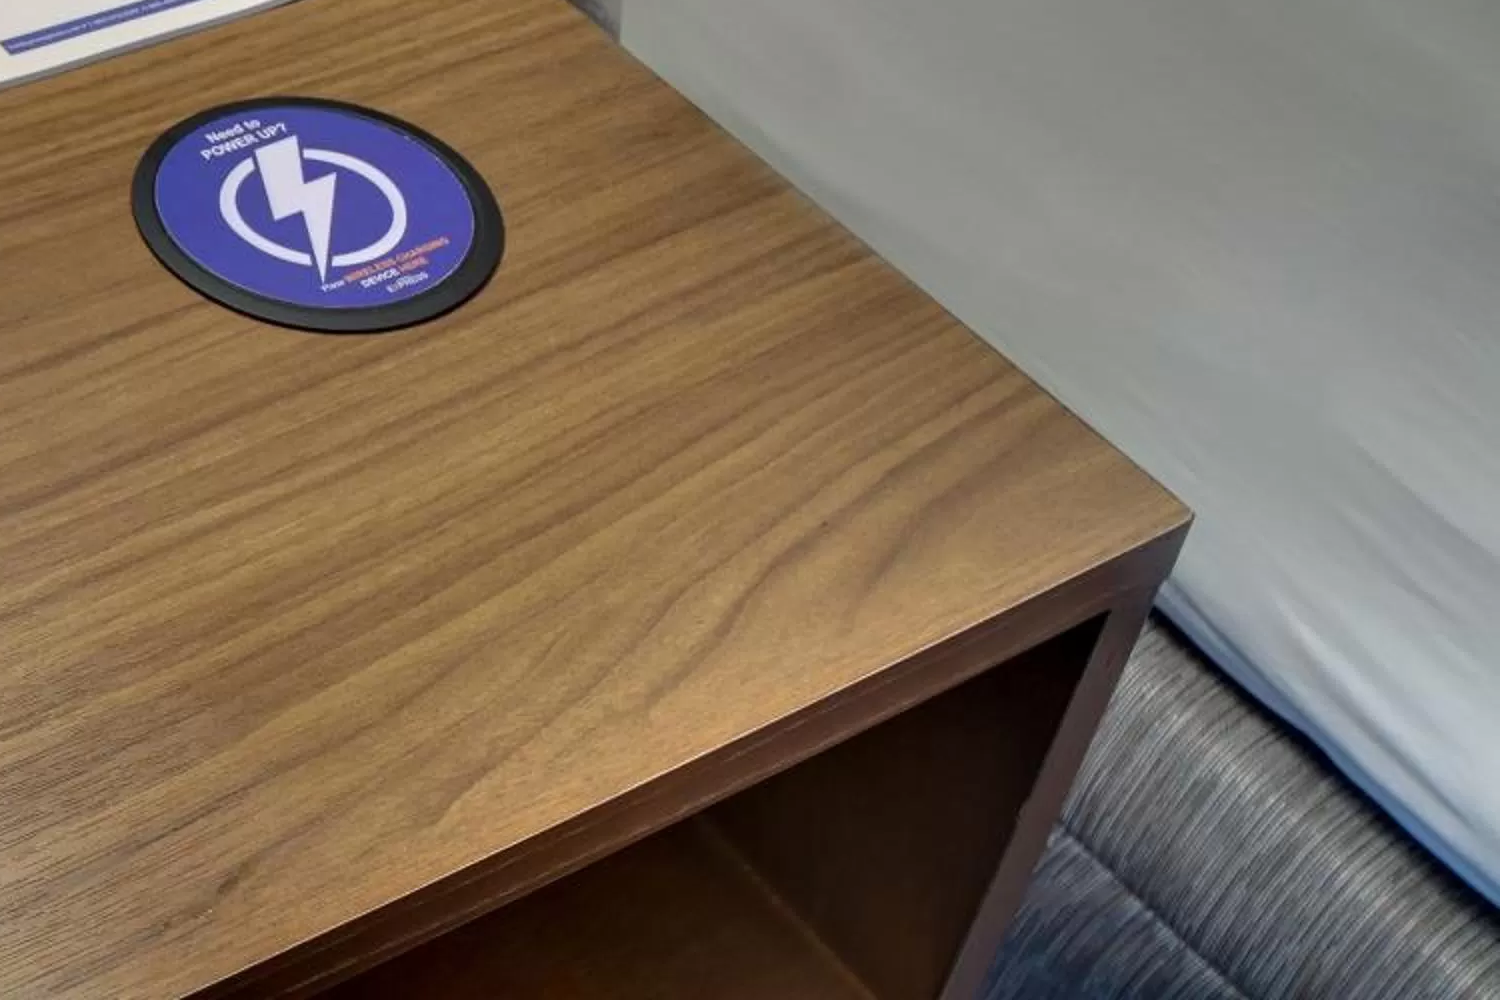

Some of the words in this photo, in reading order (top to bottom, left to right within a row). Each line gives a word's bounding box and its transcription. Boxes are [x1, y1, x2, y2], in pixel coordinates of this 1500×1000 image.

[200, 133, 259, 161] POWER
[256, 122, 287, 139] UP?
[203, 123, 245, 144] Need
[243, 119, 261, 131] to
[360, 268, 400, 289] DEVICE
[398, 256, 429, 273] HERE
